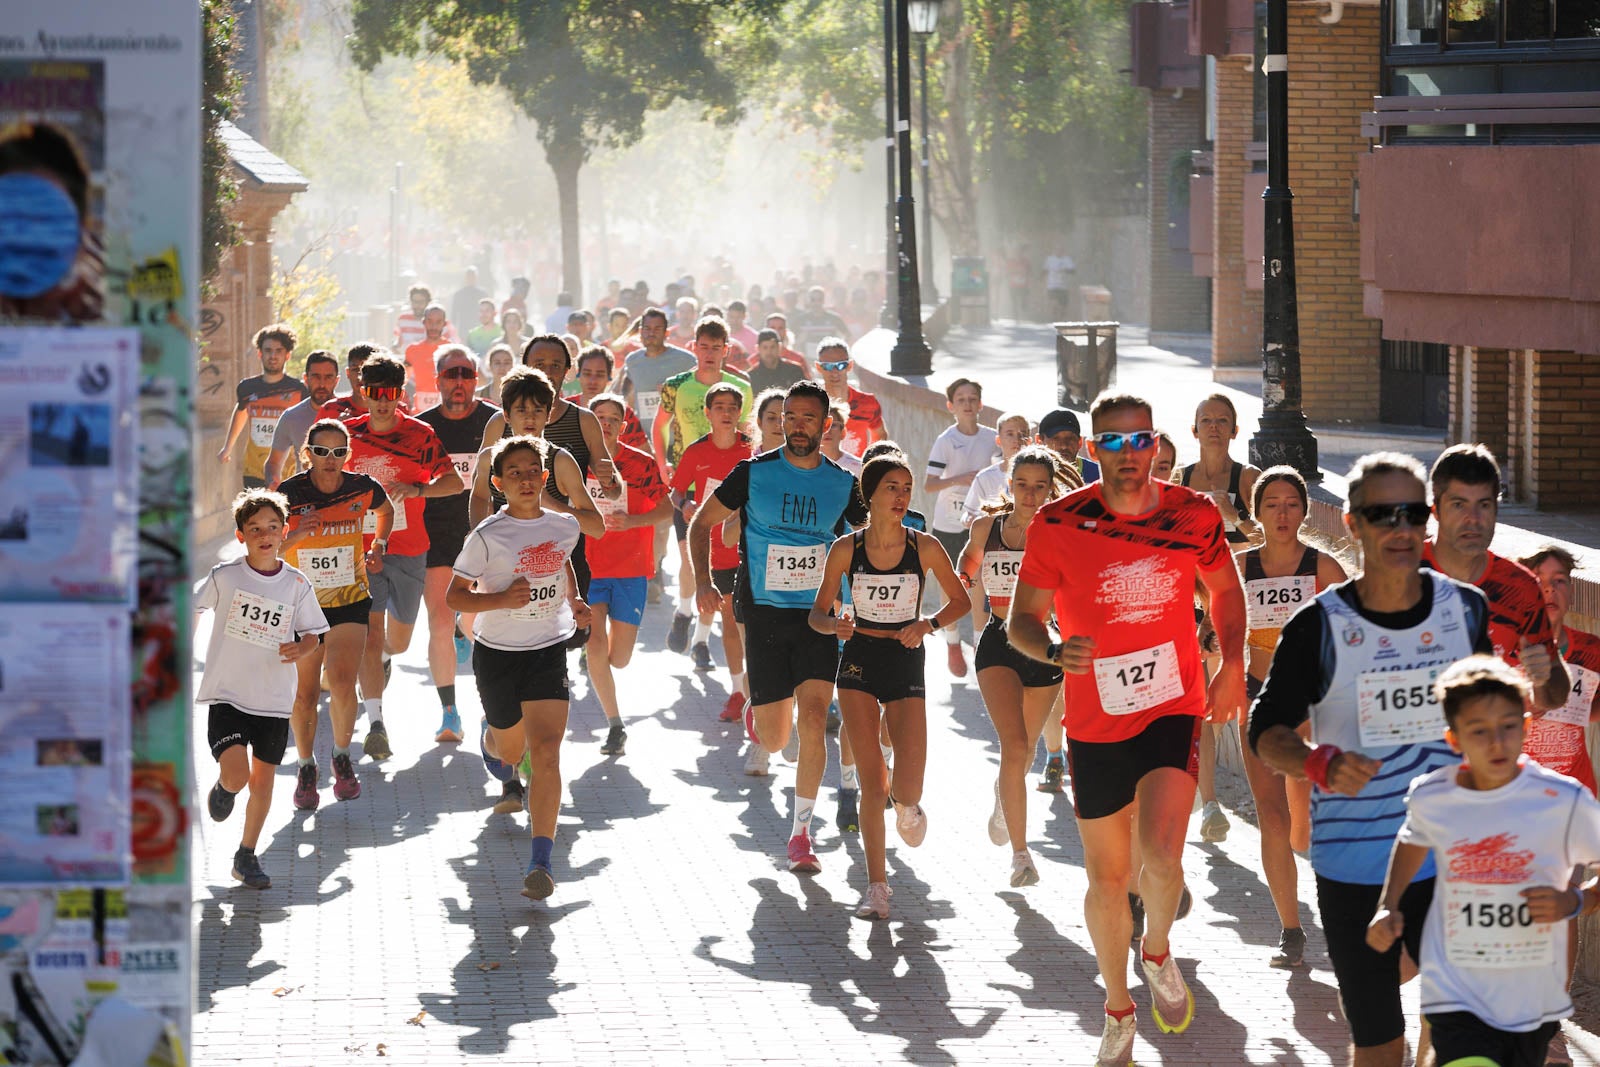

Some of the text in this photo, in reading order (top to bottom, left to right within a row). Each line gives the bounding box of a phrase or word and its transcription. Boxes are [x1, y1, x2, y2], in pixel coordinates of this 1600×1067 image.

[781, 493, 817, 527] ENA
[311, 556, 338, 569] 561
[520, 552, 563, 565] carrera
[777, 557, 816, 570] 1343
[1103, 574, 1175, 592] carrera
[530, 584, 556, 601] 306
[866, 585, 901, 600] 797
[1256, 588, 1302, 605] 1263
[241, 603, 282, 627] 1315
[1116, 661, 1156, 687] 127
[1375, 684, 1439, 711] 1655
[1461, 902, 1533, 928] 1580
